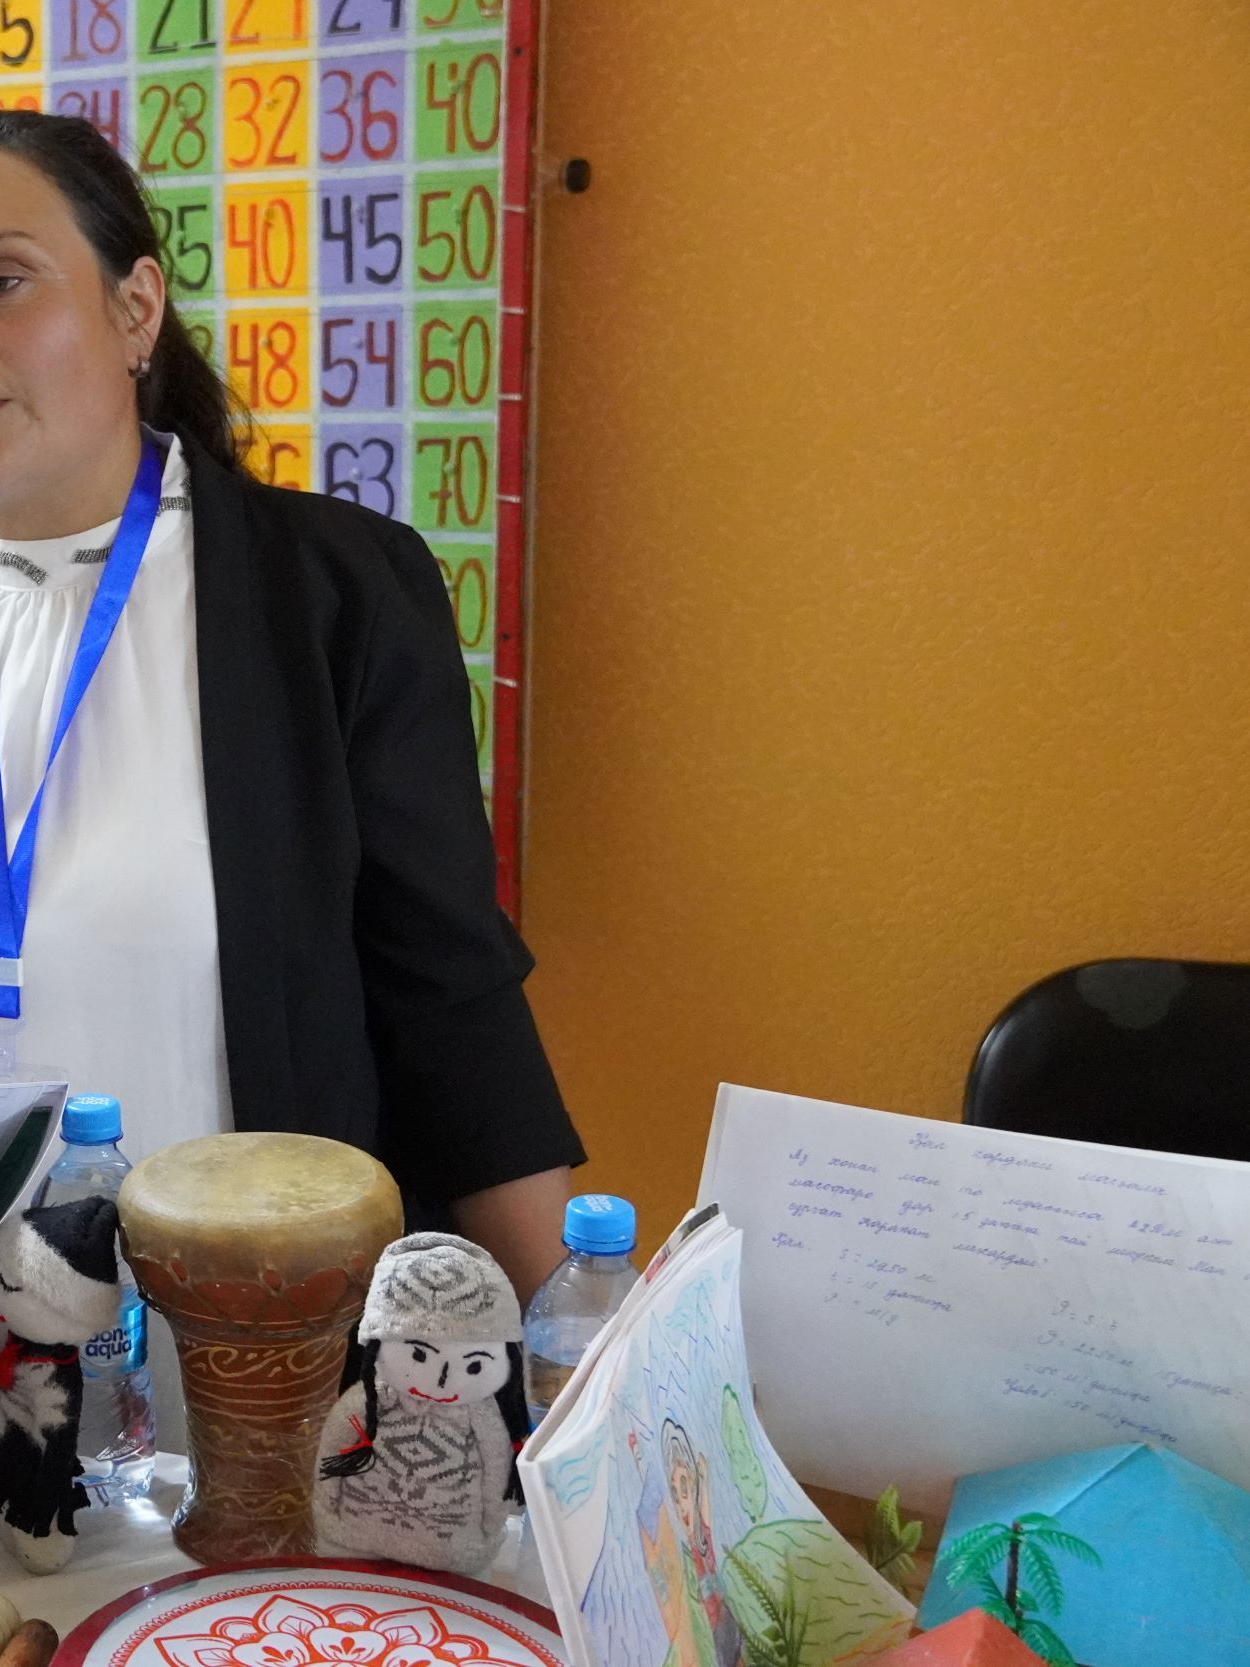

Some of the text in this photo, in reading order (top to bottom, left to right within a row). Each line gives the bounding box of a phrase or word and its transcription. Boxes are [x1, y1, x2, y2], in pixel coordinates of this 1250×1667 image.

[138, 82, 206, 172] 28
[228, 75, 301, 169] 32
[320, 70, 398, 163] 36
[425, 53, 501, 153] 40
[228, 198, 295, 289] 40
[322, 193, 403, 284] 45
[418, 184, 496, 282] 50
[230, 320, 297, 408] 48
[322, 319, 396, 407] 54
[419, 315, 491, 406] 60
[417, 436, 487, 527] 70
[85, 1339, 132, 1360] aqua
